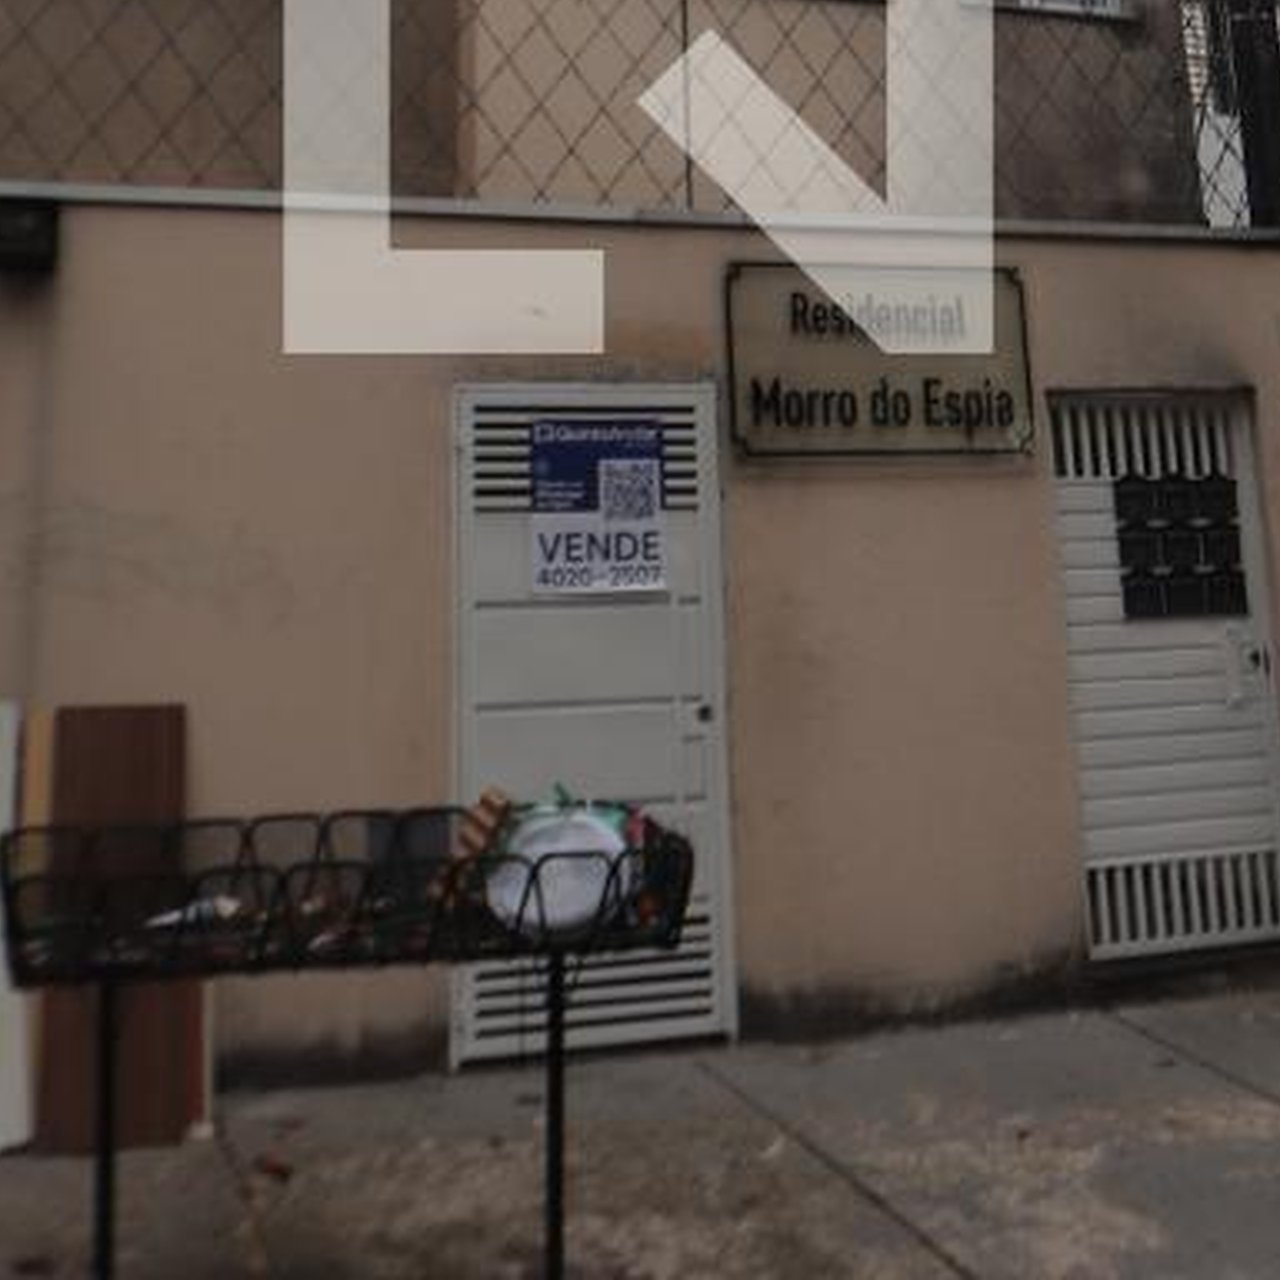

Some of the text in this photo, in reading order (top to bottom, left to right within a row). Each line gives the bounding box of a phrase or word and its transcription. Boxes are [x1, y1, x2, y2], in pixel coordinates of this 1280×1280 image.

[789, 291, 966, 339] Residencial
[749, 376, 1014, 442] Morro do Espia
[537, 531, 661, 563] VENDE
